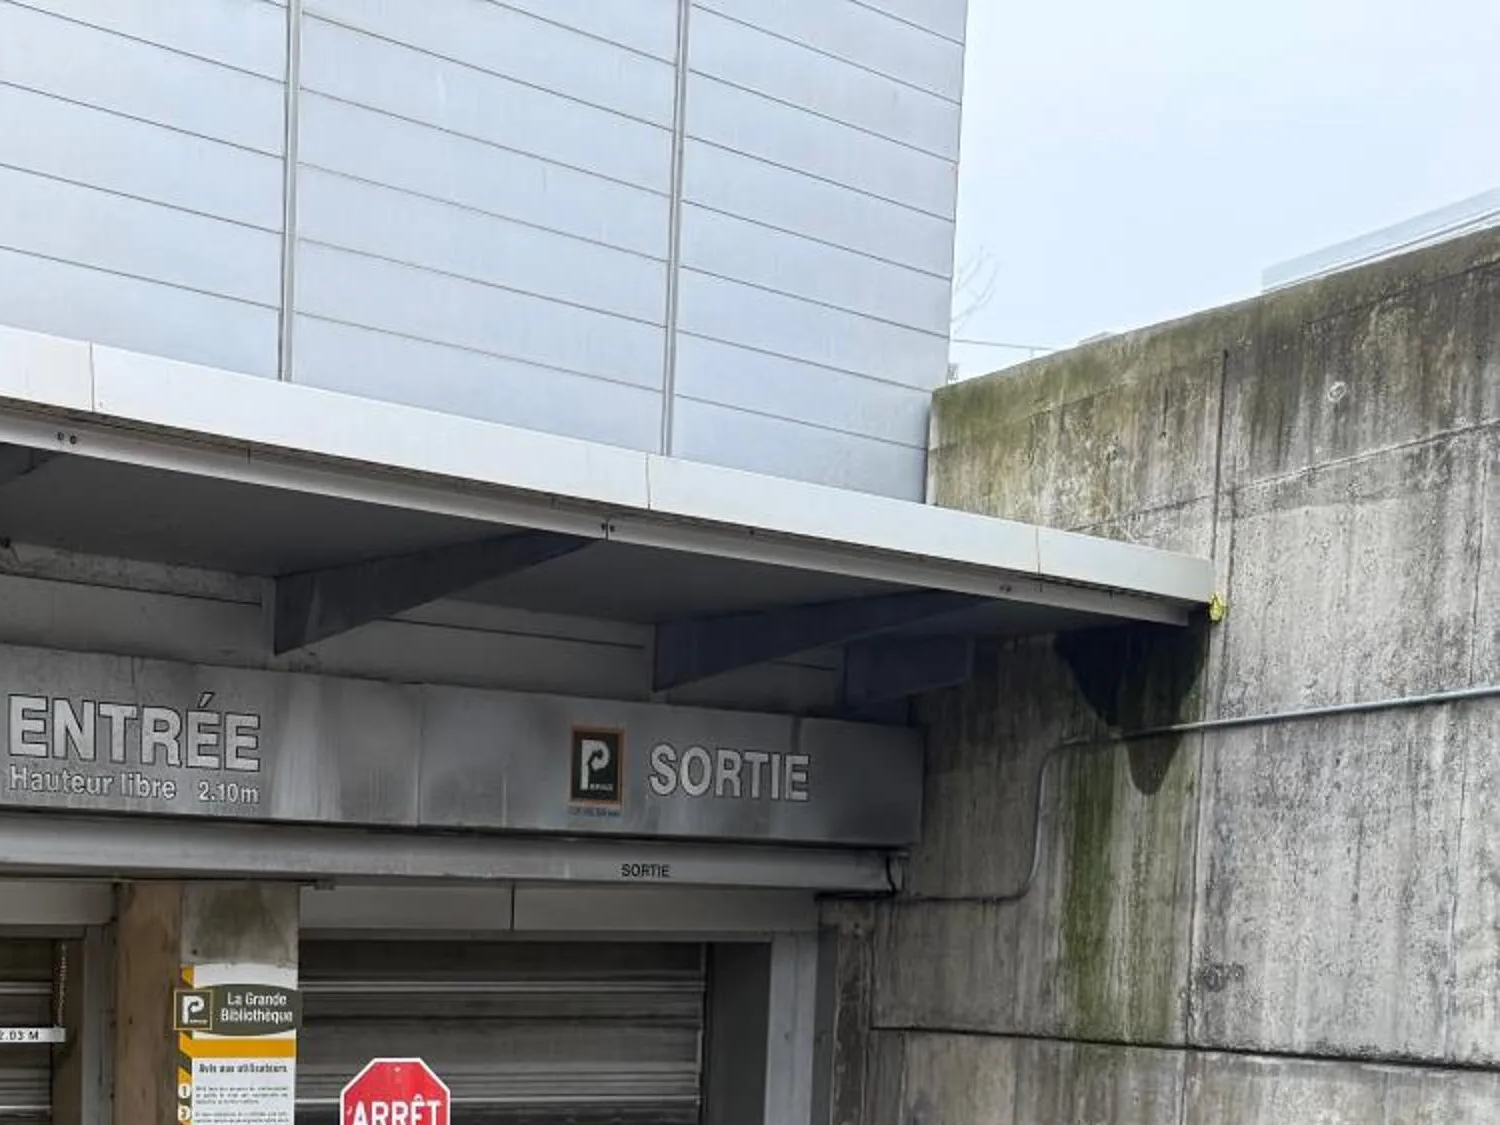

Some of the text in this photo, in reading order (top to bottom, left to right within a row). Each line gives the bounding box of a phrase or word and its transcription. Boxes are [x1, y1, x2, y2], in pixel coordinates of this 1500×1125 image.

[8, 692, 260, 771] ENTRÉE
[648, 743, 810, 802] SORTIE
[9, 764, 260, 803] Hauteur libre 2.10m
[621, 863, 670, 878] SORTIE
[227, 992, 287, 1005] La Grande
[221, 1008, 293, 1024] Bibliothèque
[28, 1030, 39, 1041] M
